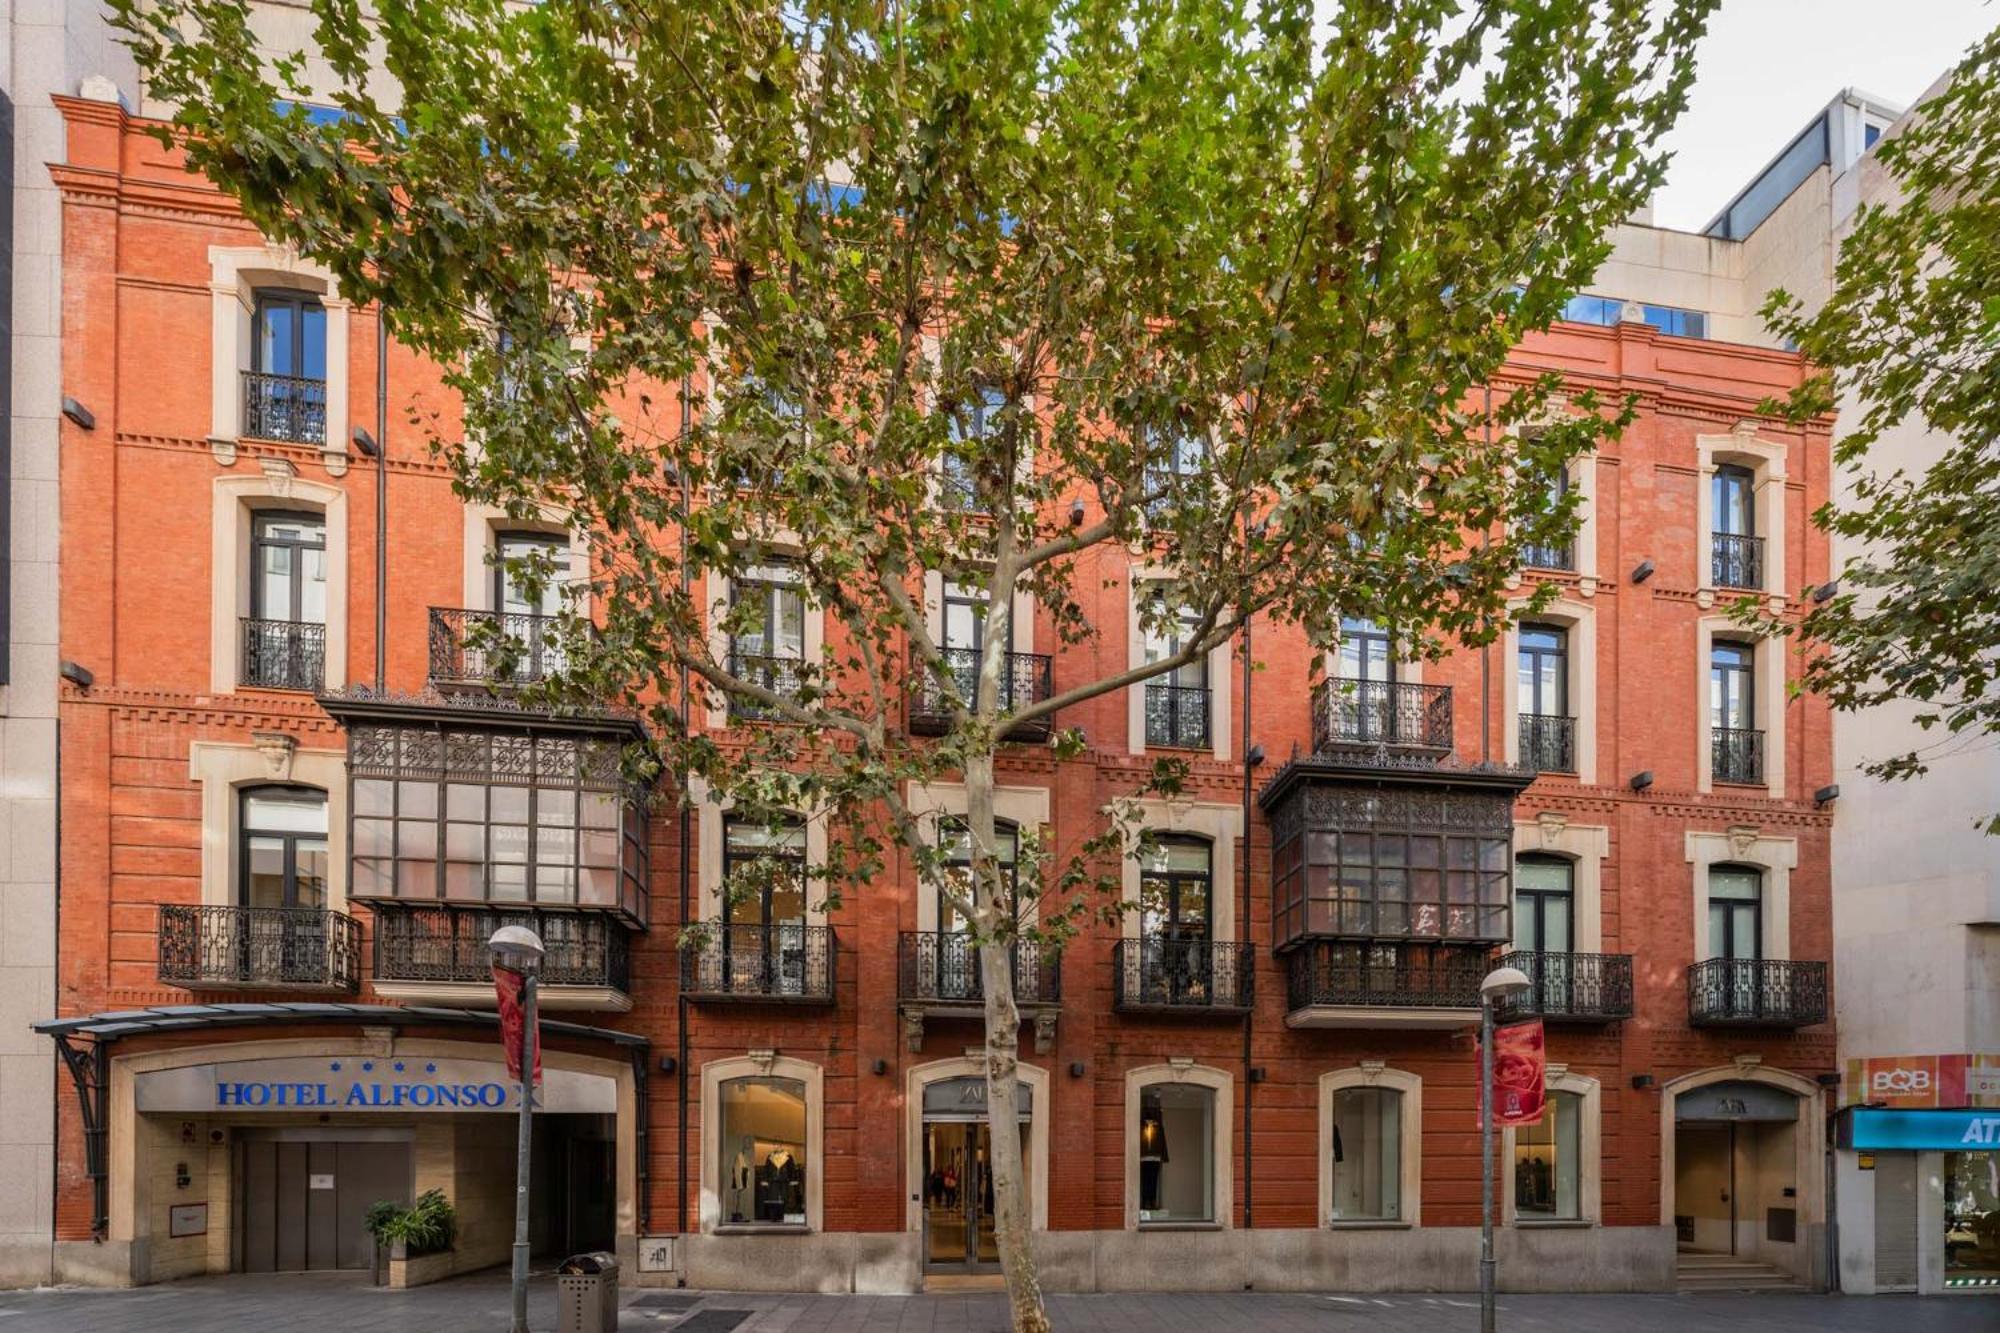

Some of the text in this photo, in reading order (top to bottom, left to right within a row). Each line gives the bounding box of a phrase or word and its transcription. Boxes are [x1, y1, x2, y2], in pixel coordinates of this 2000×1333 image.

[1873, 1068, 1930, 1091] BQB
[216, 1082, 337, 1106] HOTEL
[346, 1082, 506, 1107] ALFONSO
[1961, 1117, 2000, 1143] AT
